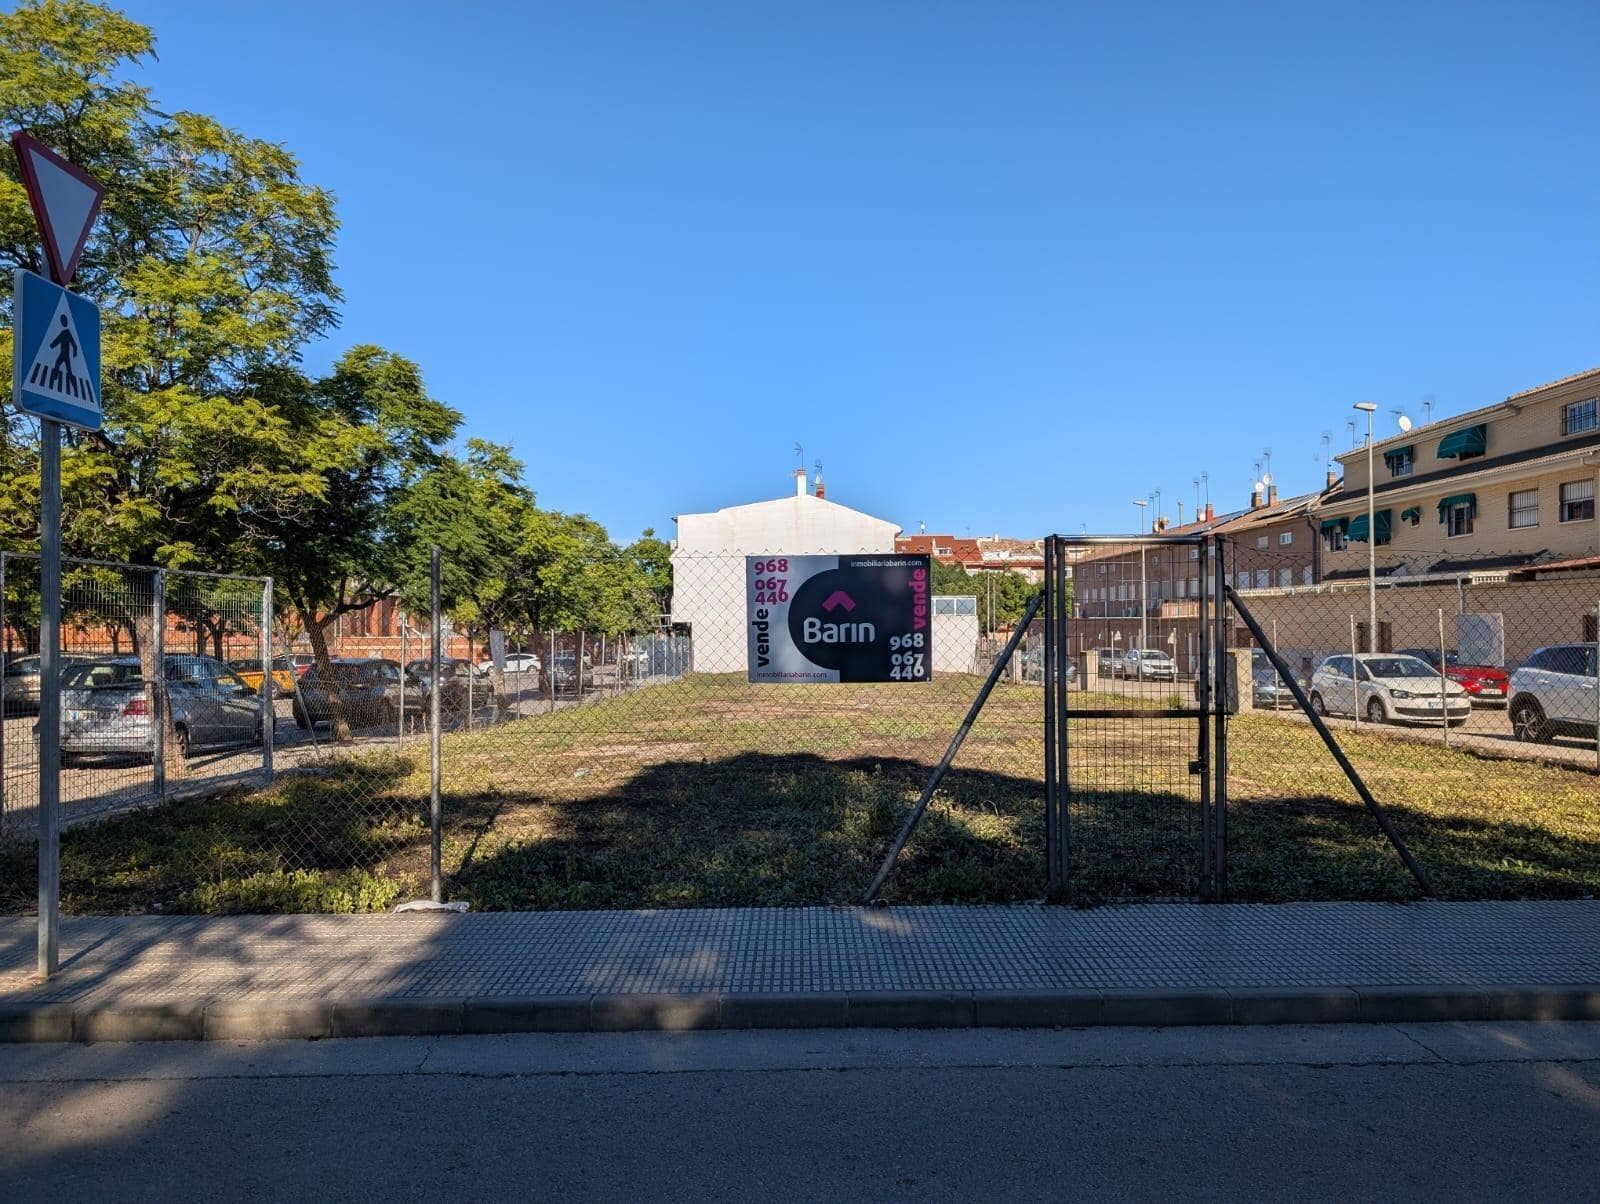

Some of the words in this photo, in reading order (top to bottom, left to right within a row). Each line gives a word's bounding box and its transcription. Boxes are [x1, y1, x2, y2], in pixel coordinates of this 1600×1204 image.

[754, 558, 788, 576] 968
[754, 576, 788, 593] 067
[909, 568, 927, 629] vende
[752, 608, 770, 668] vende
[803, 617, 875, 643] Barin
[889, 632, 925, 651] 968
[891, 650, 925, 666] 067
